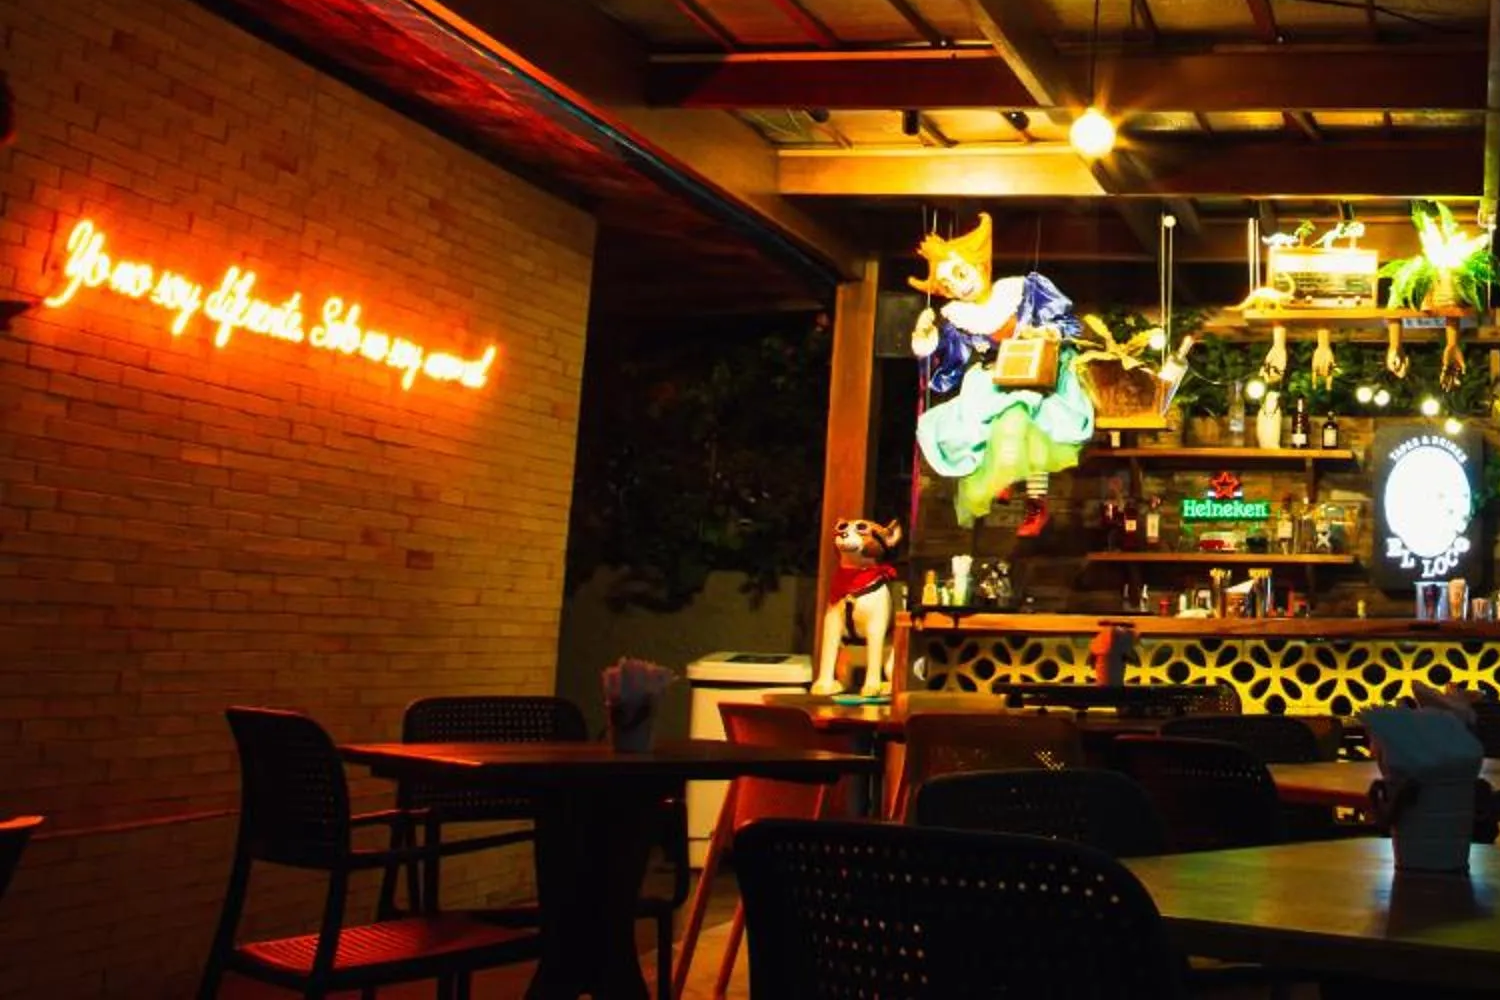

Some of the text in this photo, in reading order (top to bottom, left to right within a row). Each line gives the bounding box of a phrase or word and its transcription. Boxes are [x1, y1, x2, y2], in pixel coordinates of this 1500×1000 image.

[1183, 499, 1269, 518] Heineken
[1386, 535, 1470, 579] EL LOCO
